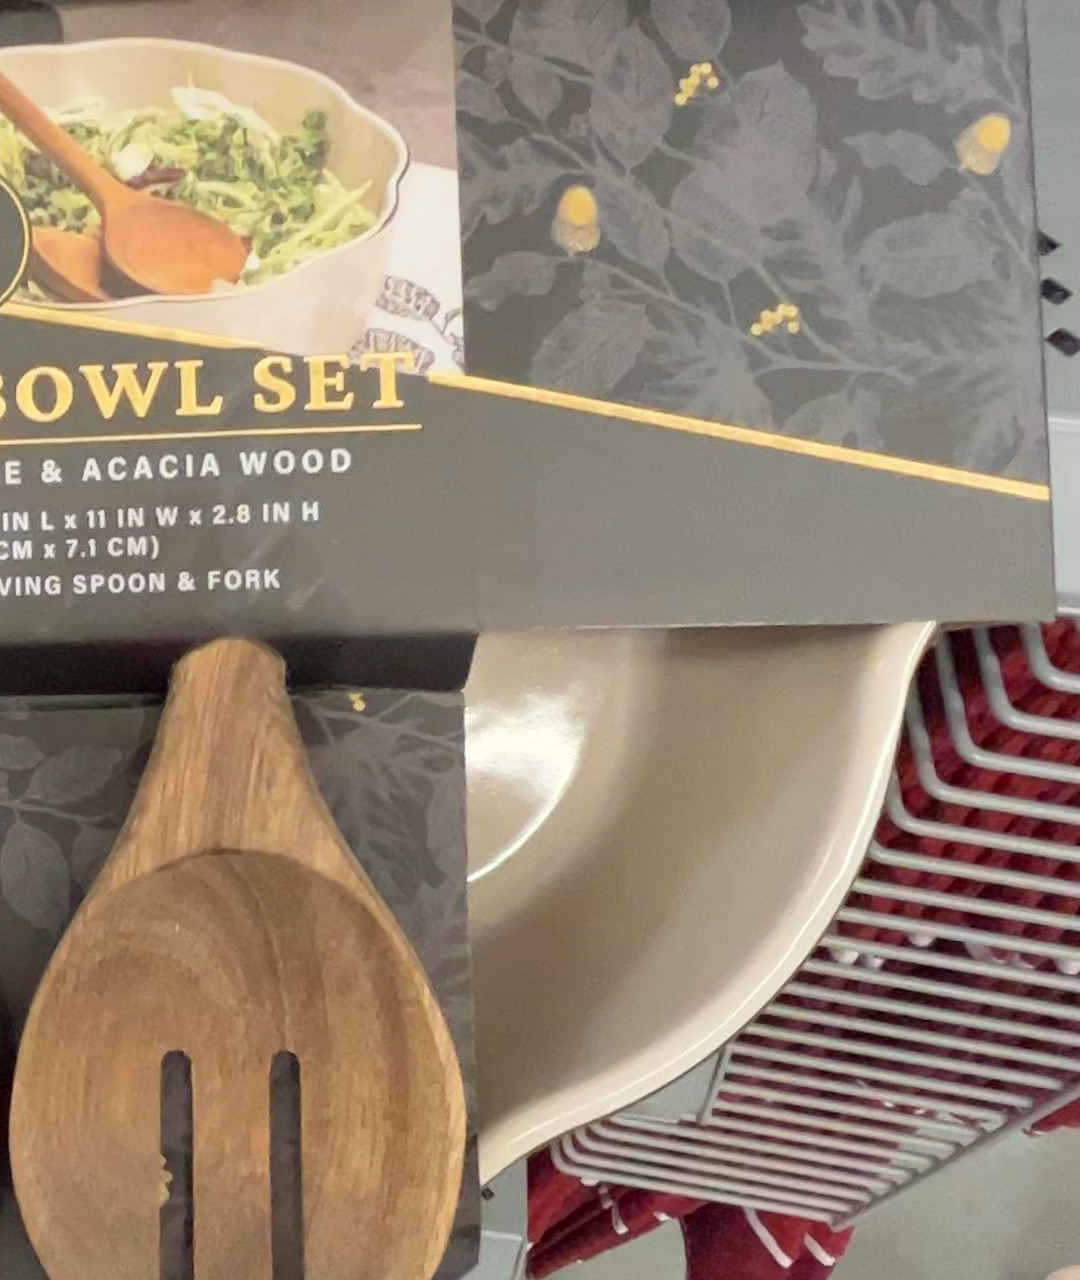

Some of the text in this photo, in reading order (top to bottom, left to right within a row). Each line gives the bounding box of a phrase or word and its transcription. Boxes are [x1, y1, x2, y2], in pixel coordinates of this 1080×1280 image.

[252, 351, 415, 413] SET
[41, 459, 63, 483] &
[81, 452, 221, 482] ACACIA
[239, 448, 352, 477] WOOD
[3, 511, 29, 532] IN
[40, 511, 54, 531] L
[64, 514, 77, 529] x
[87, 509, 106, 528] 11
[118, 507, 144, 528] IN
[155, 506, 179, 527] W
[189, 508, 202, 525] x
[213, 504, 251, 525] 2.8
[262, 502, 290, 523] IN
[302, 500, 320, 522] H
[43, 542, 56, 559] x
[65, 539, 97, 558] 7.1
[107, 535, 160, 560] CM)
[72, 571, 166, 596] SPOON
[177, 571, 195, 592] &
[207, 568, 281, 591] FORK
